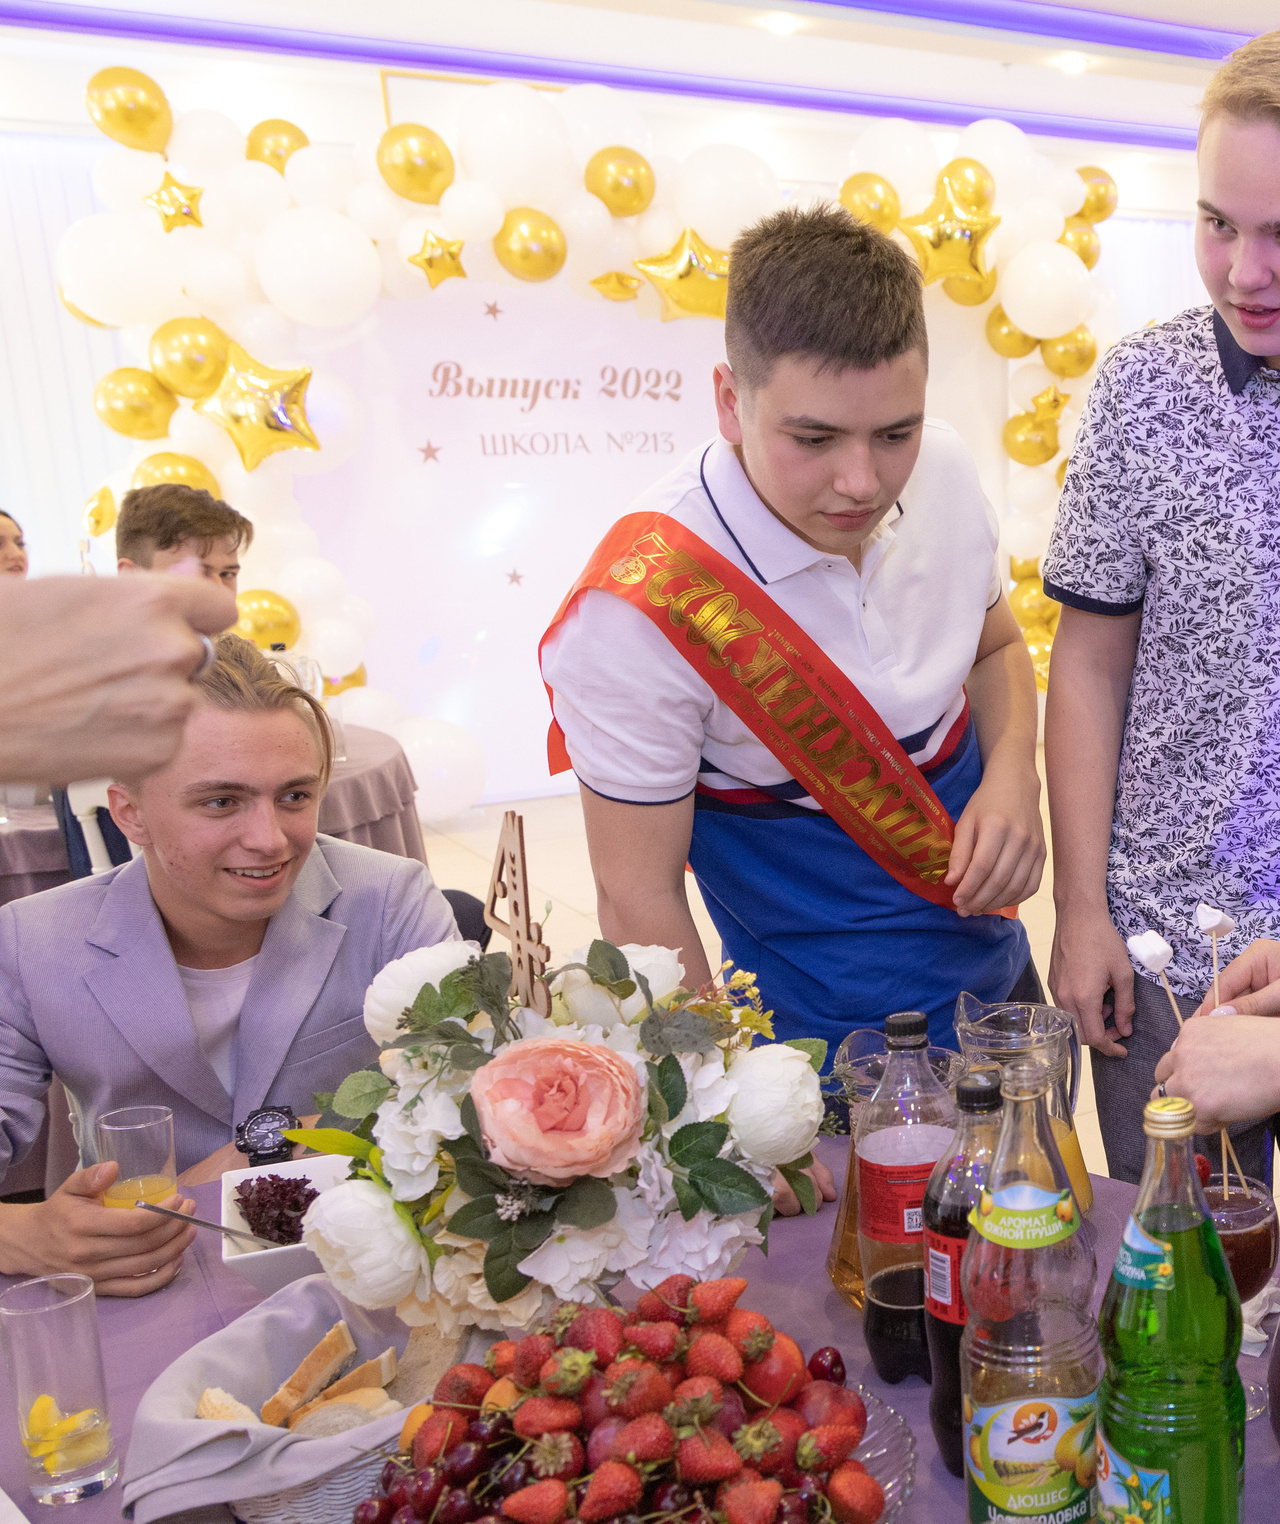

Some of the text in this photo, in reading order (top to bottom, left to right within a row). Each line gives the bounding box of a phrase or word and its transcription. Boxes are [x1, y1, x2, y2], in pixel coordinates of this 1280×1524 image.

[429, 361, 682, 412] Выпуск 2022
[480, 431, 675, 456] ШКОЛА №213
[645, 549, 766, 668] 2022
[983, 1219, 1064, 1240] ЮЖНОЙ ГРУШИ
[999, 1214, 1048, 1229] АРОМАТ
[1007, 1487, 1068, 1510] ДЮШЕС
